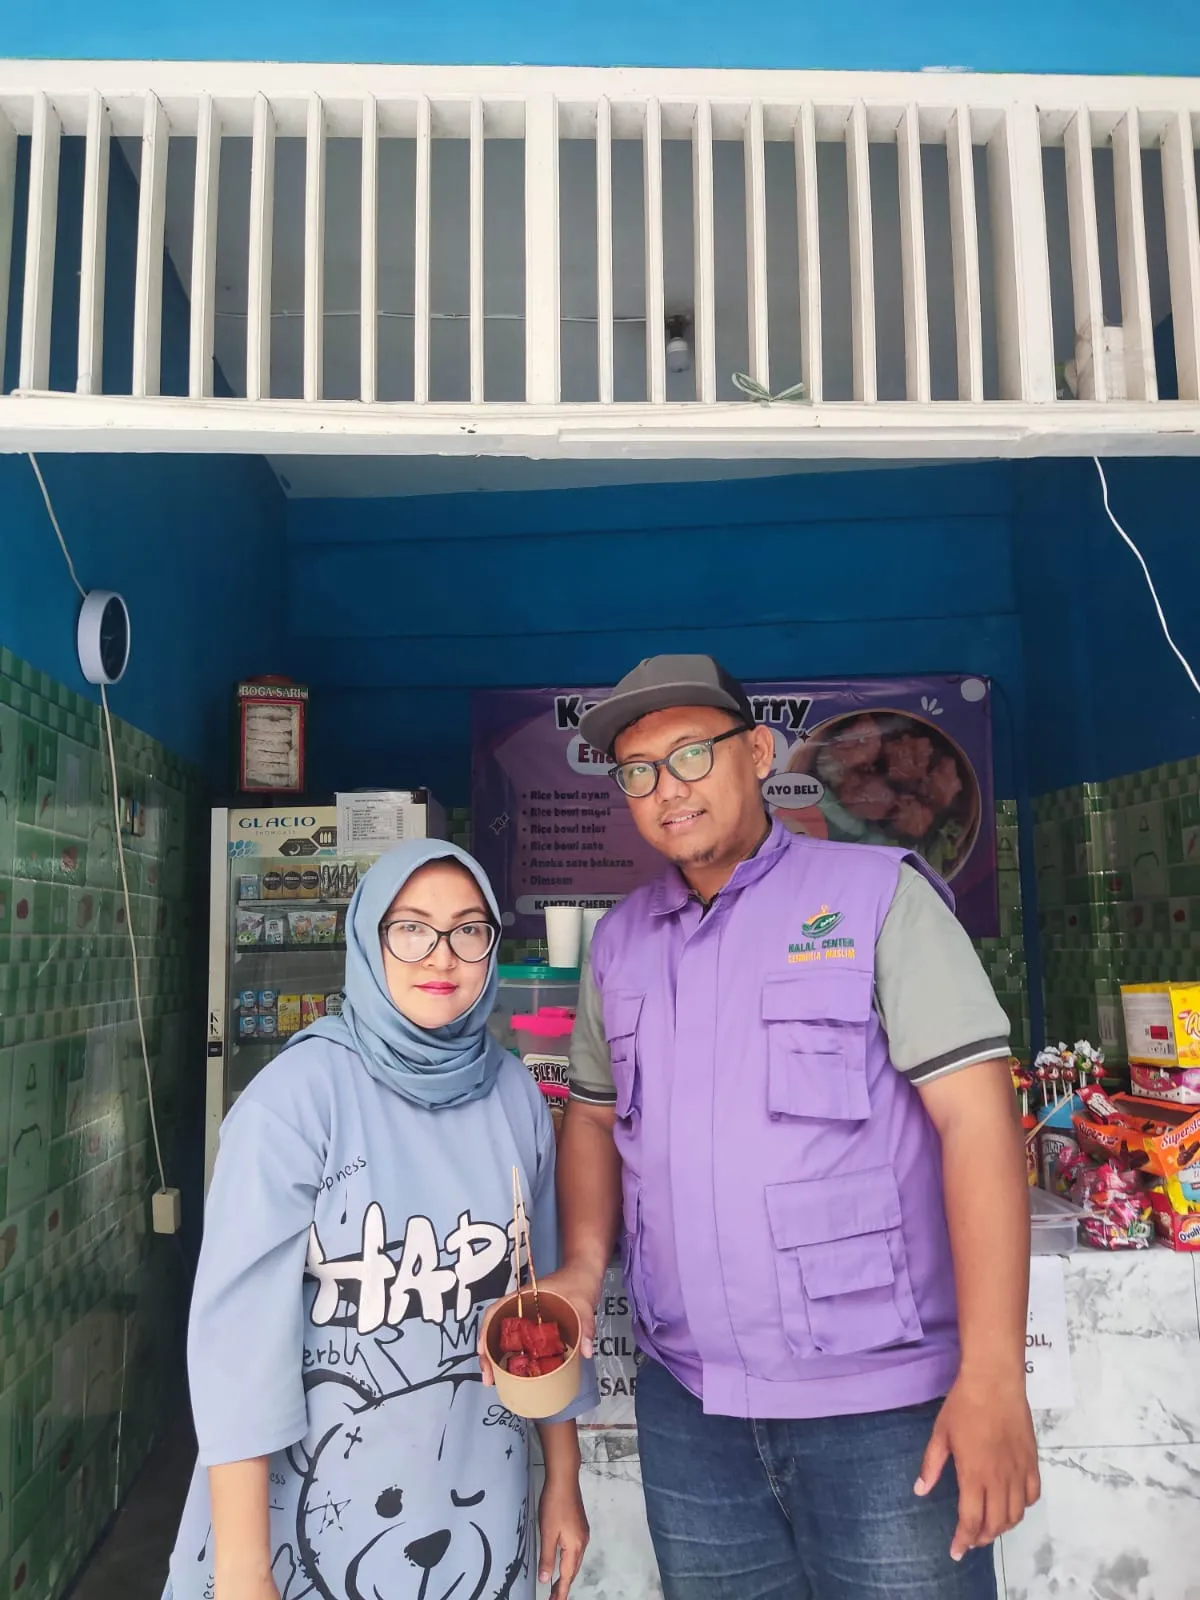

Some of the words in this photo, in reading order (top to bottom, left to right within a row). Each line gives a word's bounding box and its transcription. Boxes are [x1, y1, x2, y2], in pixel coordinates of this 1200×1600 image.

[767, 786, 791, 795] AYO
[794, 785, 819, 795] BELI
[530, 790, 552, 800] Rice
[554, 790, 579, 800] bowl
[581, 791, 610, 801] ayam
[530, 808, 552, 817] Rice
[238, 816, 316, 829] GLACIO
[530, 824, 552, 834] Rice
[554, 824, 579, 834] bowl
[530, 842, 552, 851] Rice
[554, 842, 579, 851] bowl
[788, 941, 816, 953] HALAL
